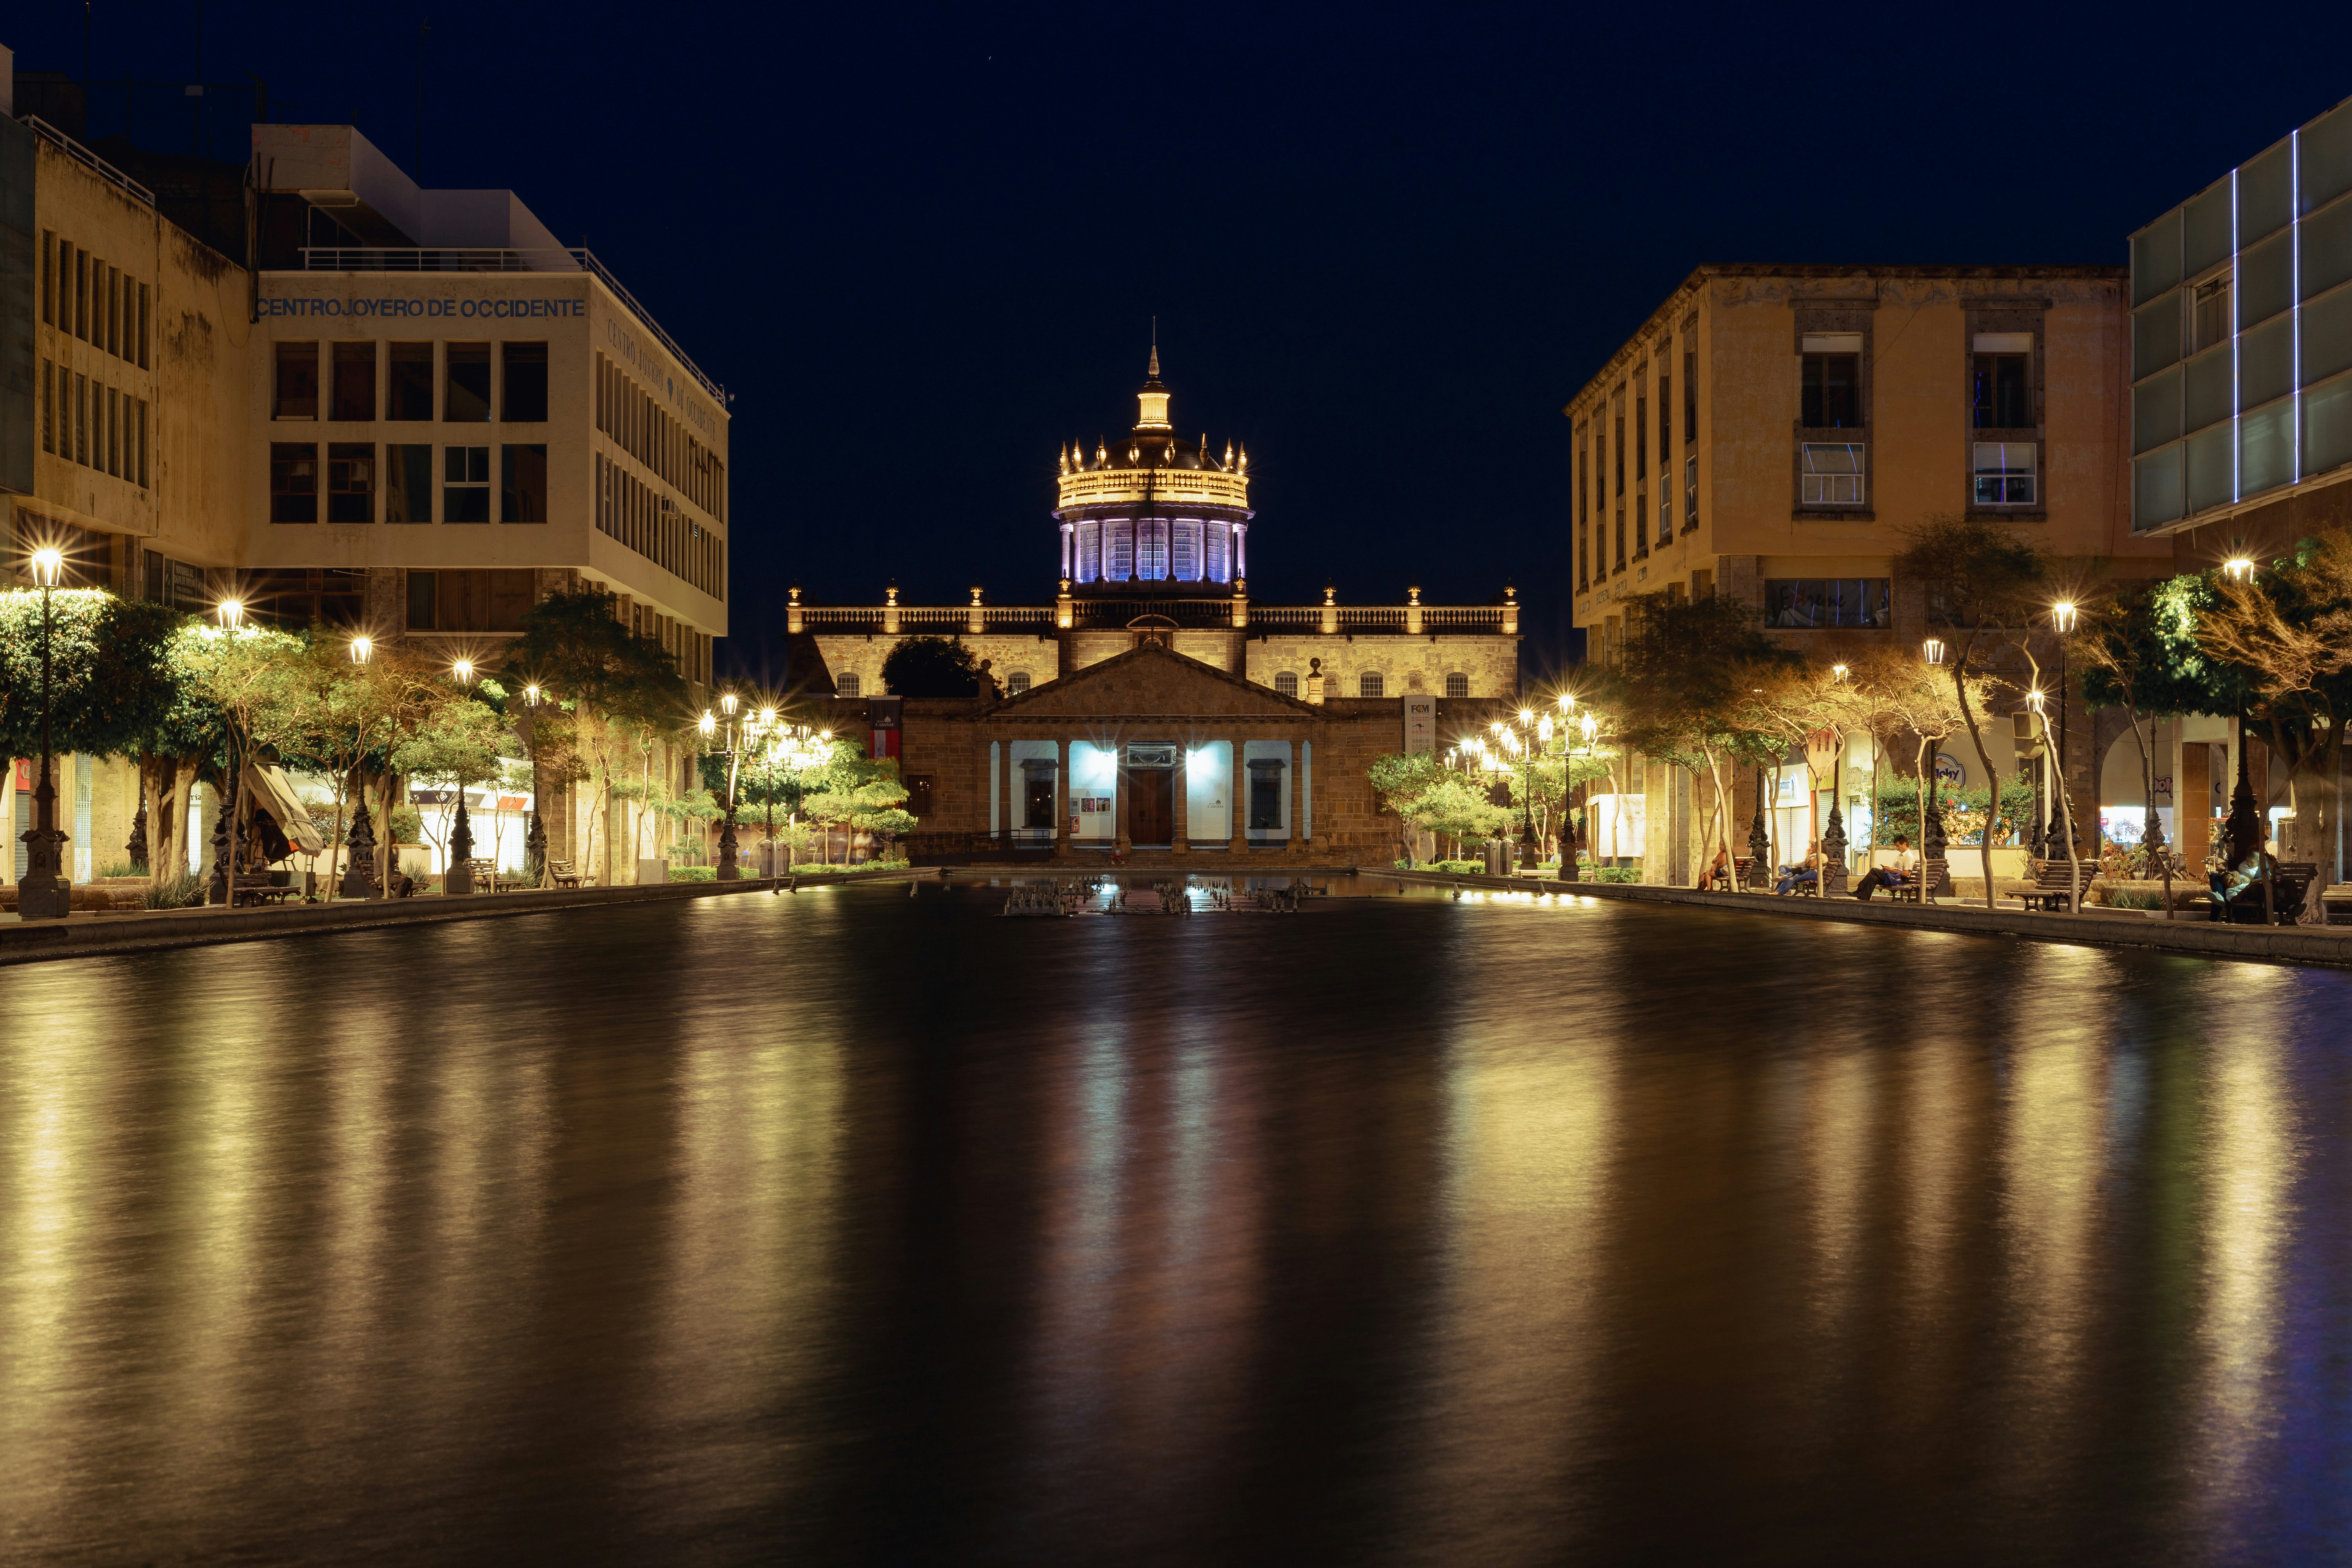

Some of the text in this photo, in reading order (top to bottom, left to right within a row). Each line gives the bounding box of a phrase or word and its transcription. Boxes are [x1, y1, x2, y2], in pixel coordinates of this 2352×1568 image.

[428, 299, 456, 317] DE
[461, 299, 585, 318] OCCIDENTE
[608, 318, 715, 442] CENTRO JOYERO DE OCCIDENTE
[1936, 768, 1960, 781] lphy
